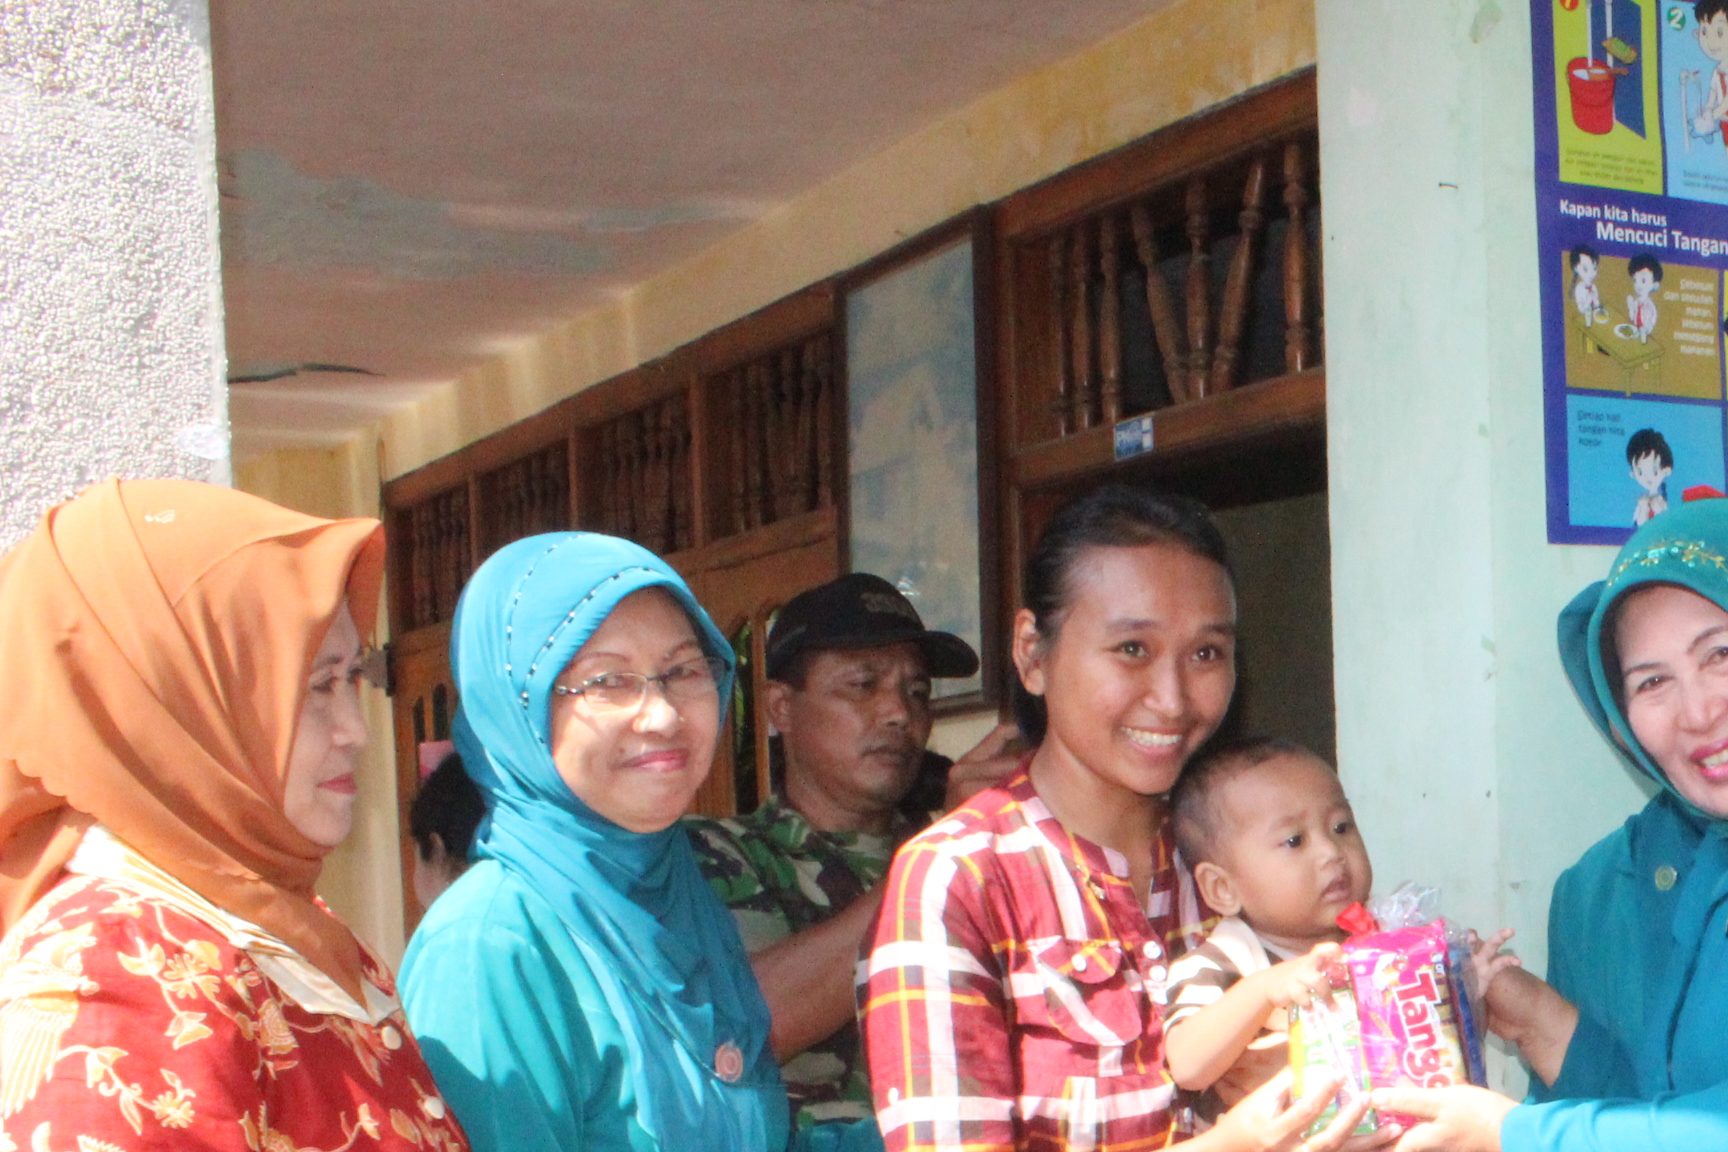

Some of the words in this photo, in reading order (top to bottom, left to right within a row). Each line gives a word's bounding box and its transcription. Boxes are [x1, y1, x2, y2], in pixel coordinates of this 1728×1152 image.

[1670, 9, 1684, 28] 2
[1559, 199, 1601, 219] Kapan
[1603, 203, 1629, 222] kita
[1631, 207, 1667, 227] harus
[1596, 221, 1668, 248] Mencuci
[1395, 969, 1454, 1088] Tango
